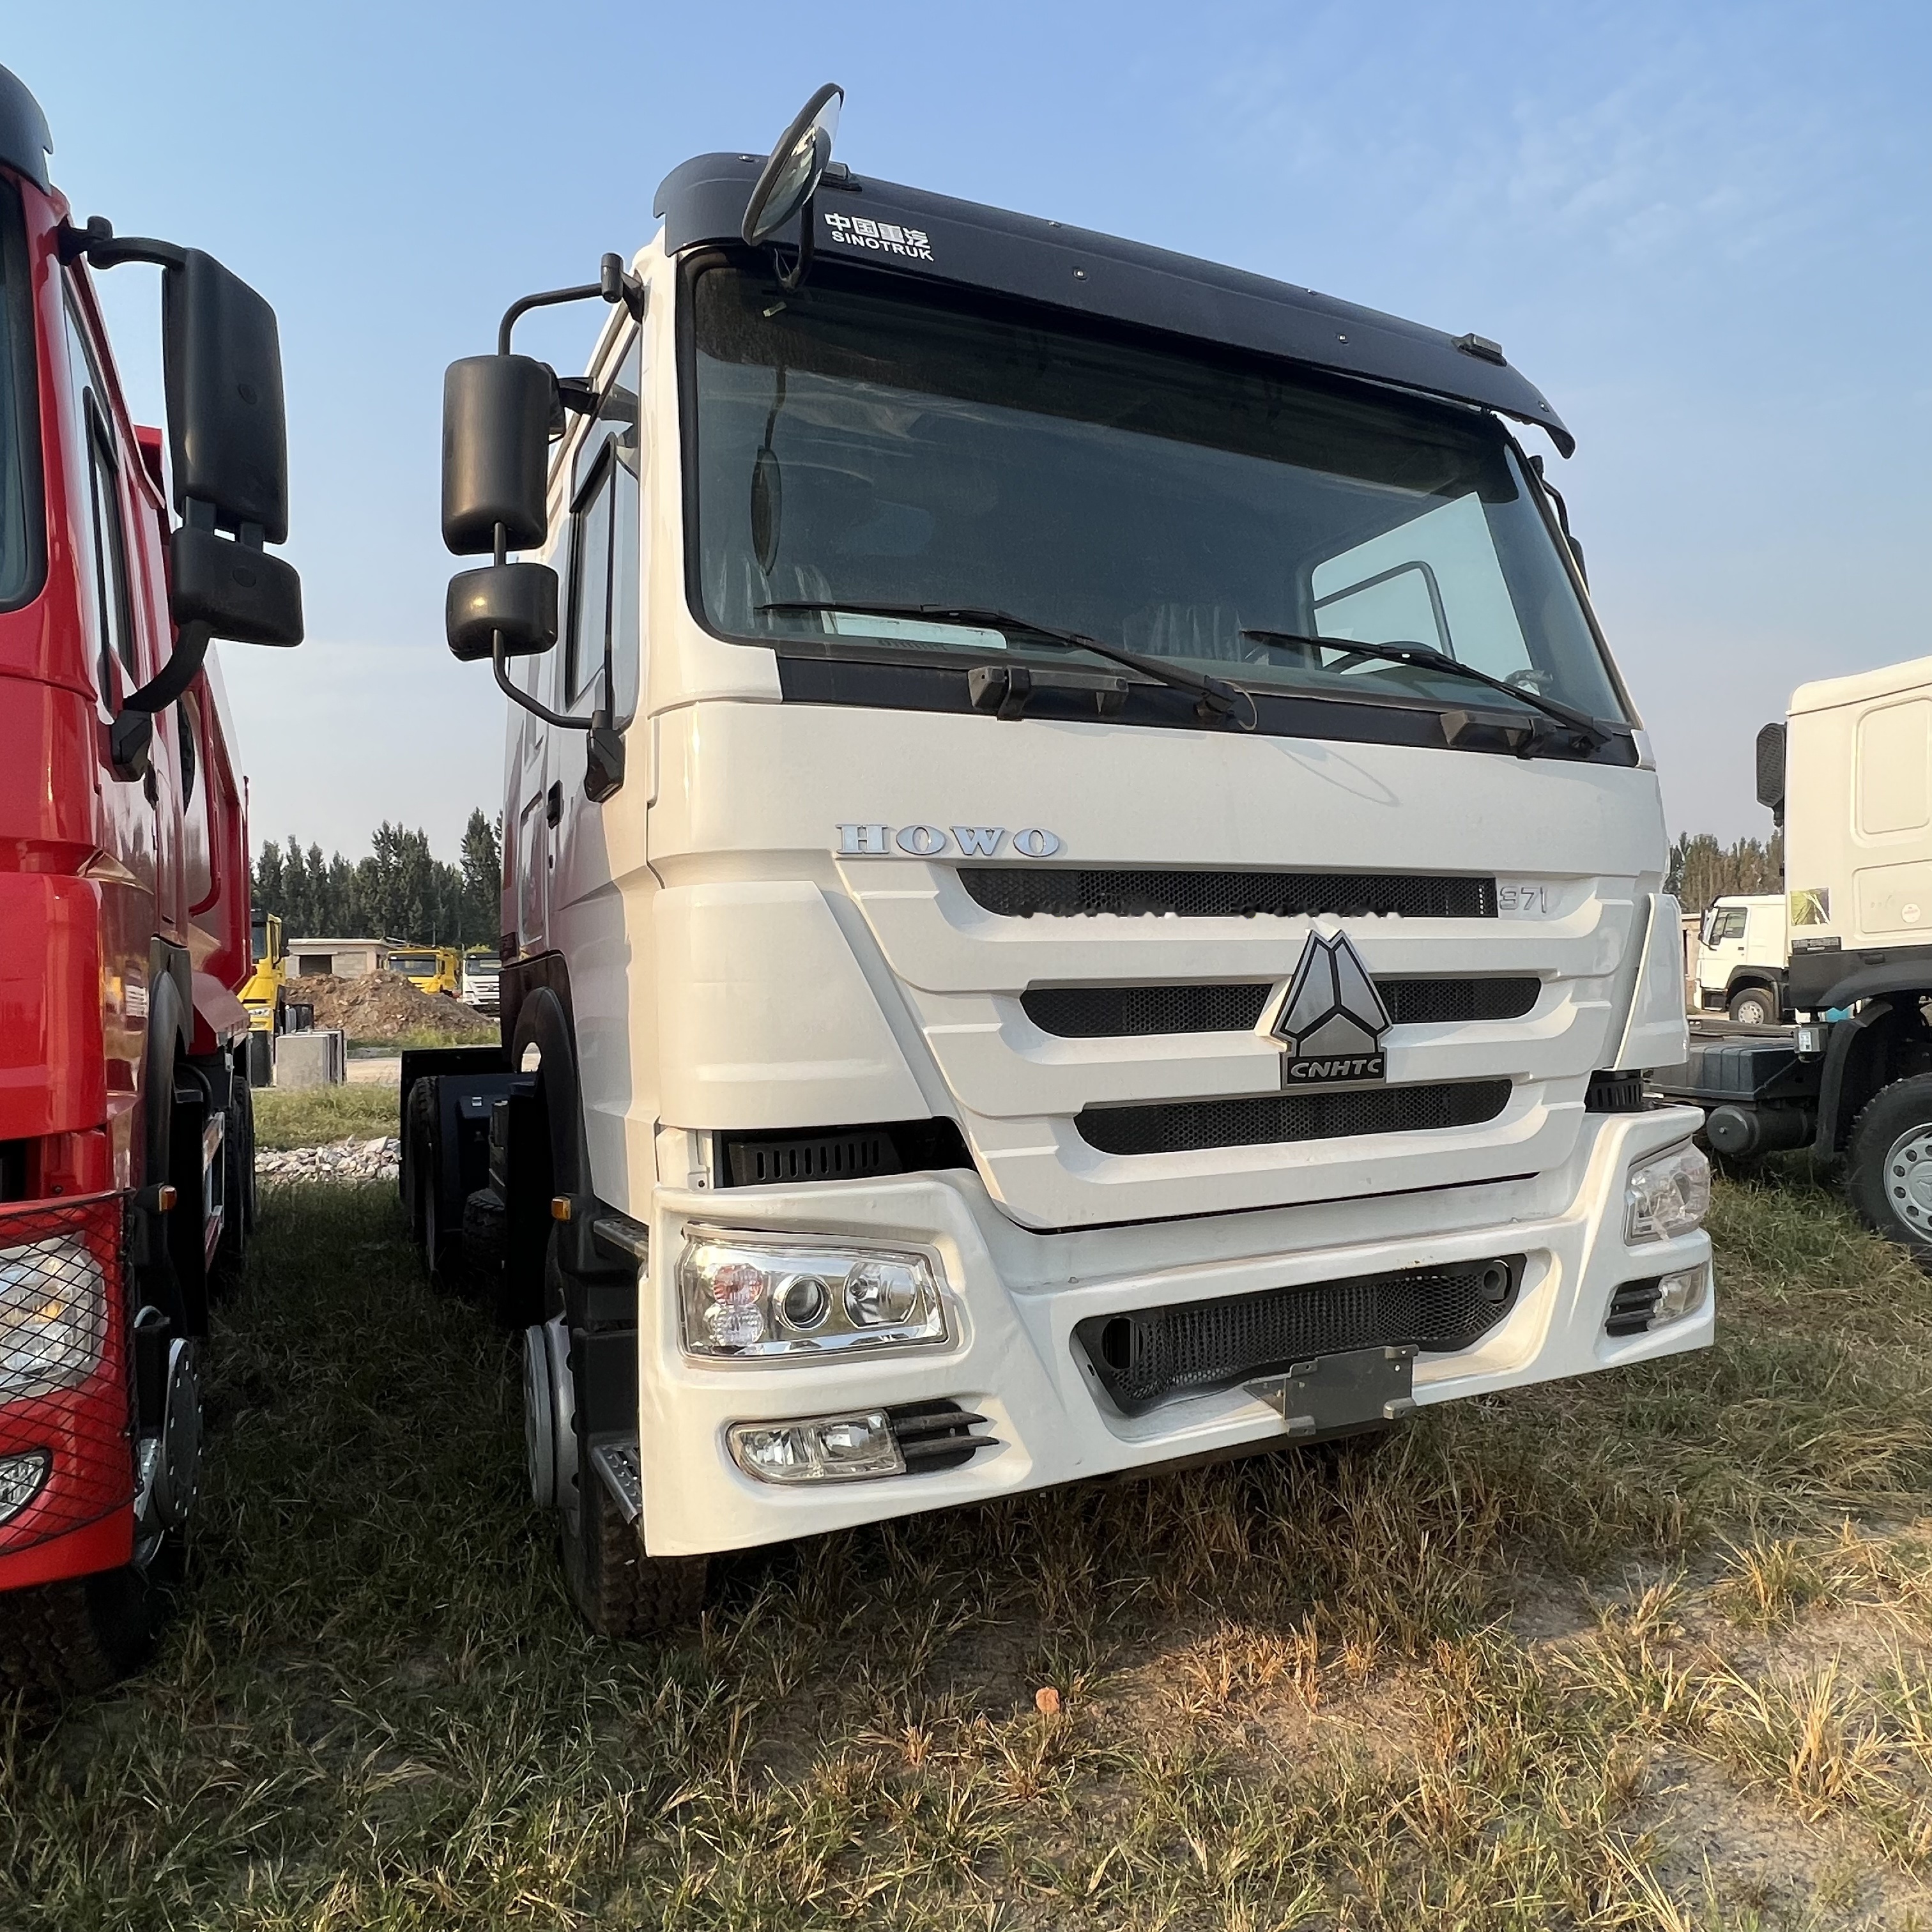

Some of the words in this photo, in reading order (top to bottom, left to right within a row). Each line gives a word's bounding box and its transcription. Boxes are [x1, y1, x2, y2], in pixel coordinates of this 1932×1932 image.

[831, 231, 934, 261] SINOTRUK
[835, 824, 1060, 857] HOWO
[1291, 1058, 1382, 1078] CNHTC
